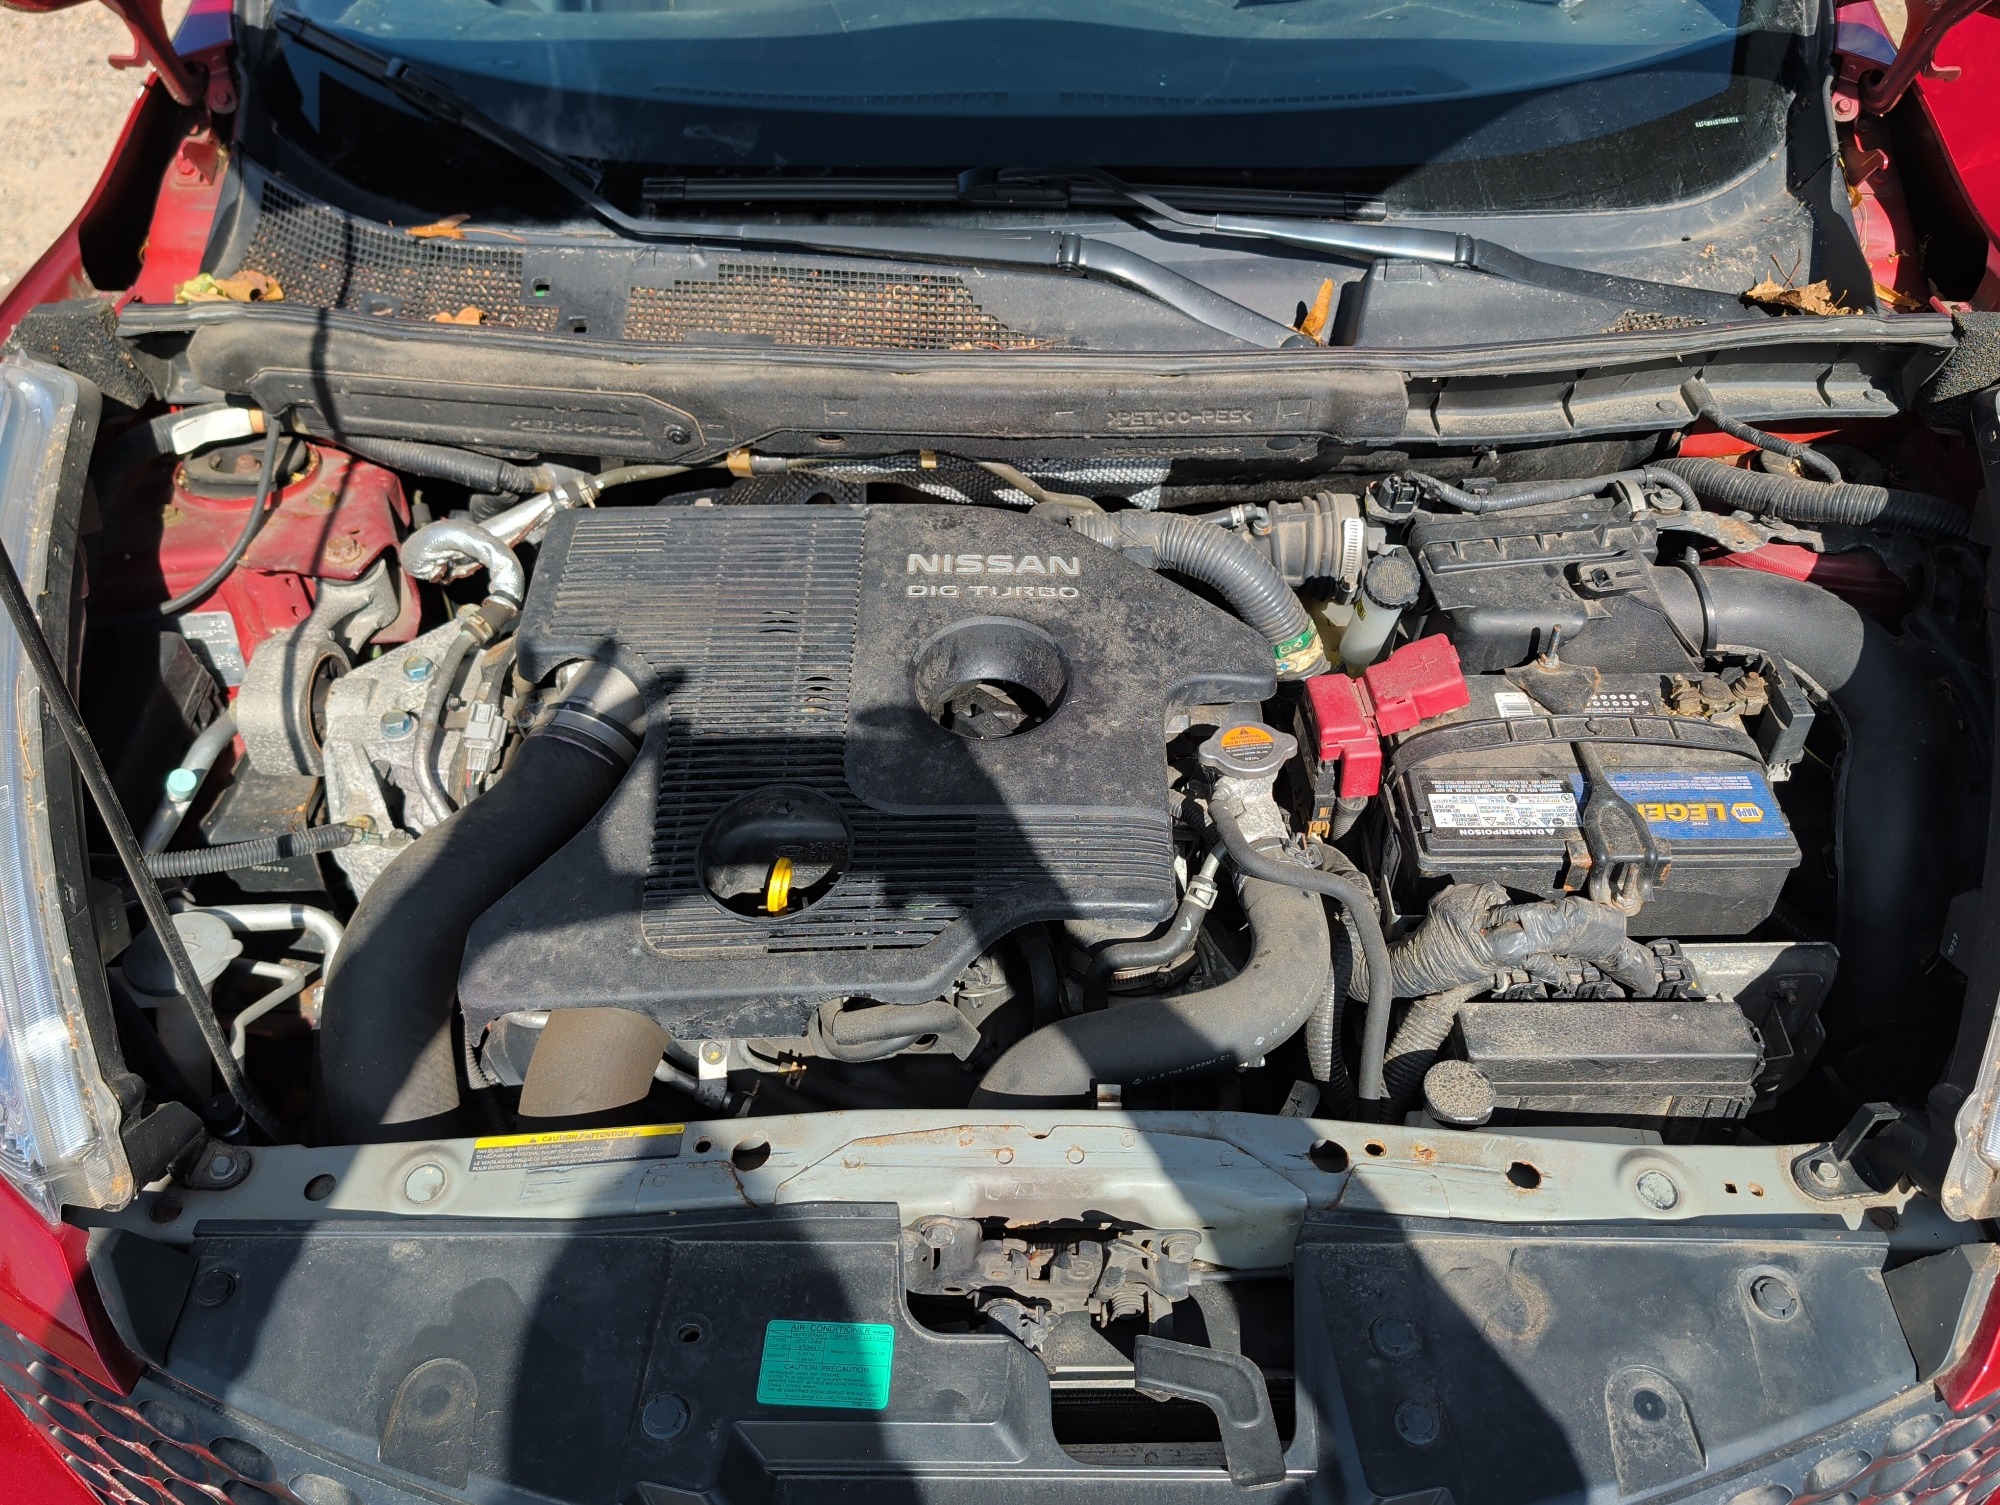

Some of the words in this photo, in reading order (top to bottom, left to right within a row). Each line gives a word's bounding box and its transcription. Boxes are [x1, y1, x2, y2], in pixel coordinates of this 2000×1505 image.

[908, 553, 1080, 575] NISSAN
[908, 585, 959, 597] DIG
[968, 585, 1080, 598] TURBO
[1634, 802, 1728, 822] LEGE
[1735, 807, 1759, 817] NAPA
[793, 866, 831, 875] ISSAN
[542, 1133, 578, 1142] CAUTION
[586, 1130, 630, 1139] ATTENTION
[810, 1325, 871, 1334] CONDITIONER
